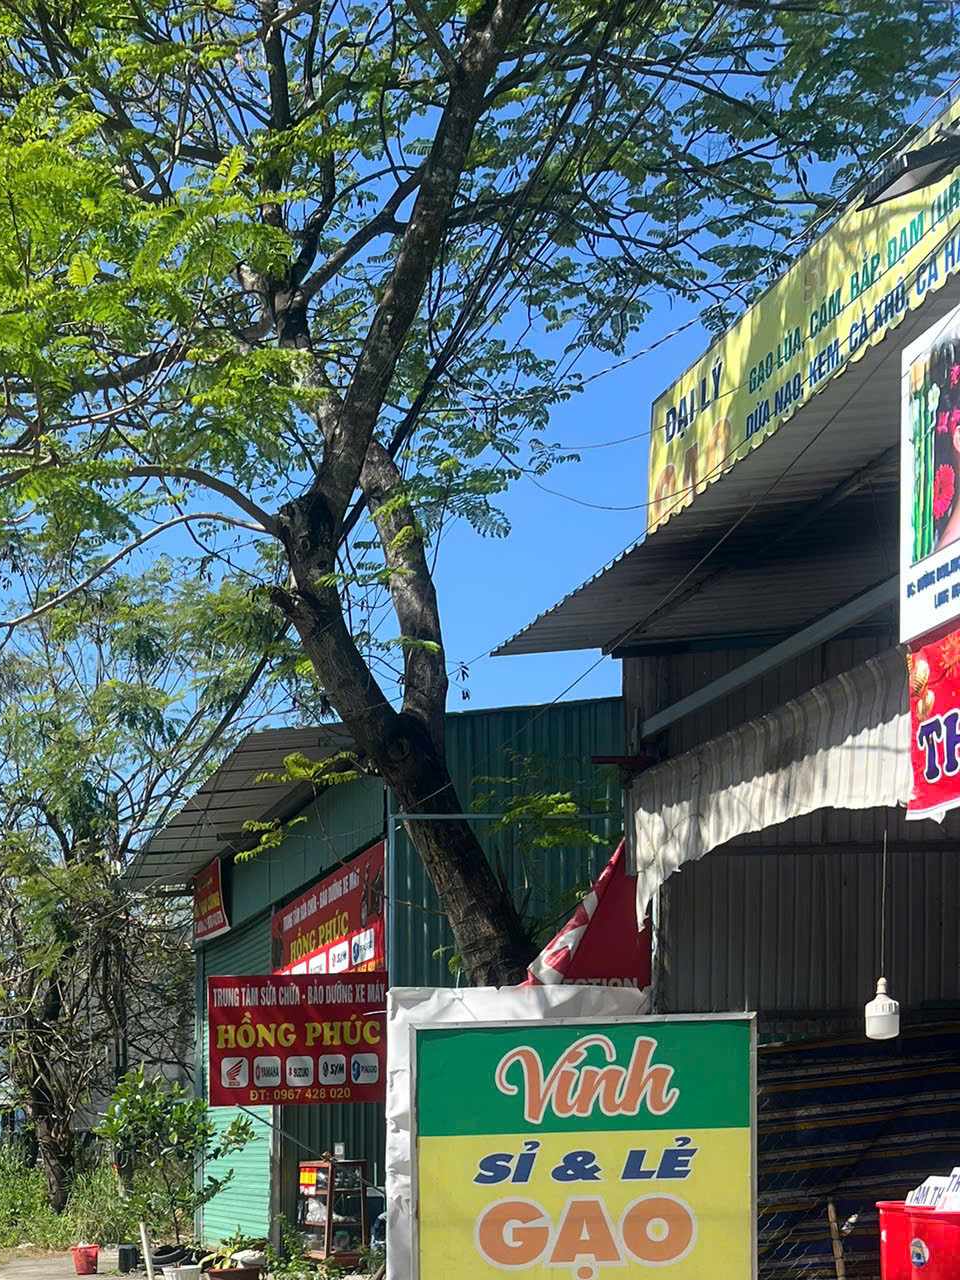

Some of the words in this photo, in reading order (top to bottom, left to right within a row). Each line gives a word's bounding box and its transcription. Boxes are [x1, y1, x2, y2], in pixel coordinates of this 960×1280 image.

[746, 401, 769, 440] DỪA
[849, 309, 869, 352] CÁ
[945, 235, 960, 272] H
[749, 352, 773, 394] GẠO
[665, 388, 695, 443] ĐẠI
[701, 356, 722, 412] LÝ
[318, 909, 349, 948] PHÚC
[213, 987, 240, 1008] TRUNG
[241, 983, 259, 1007] TÂM
[260, 980, 277, 1006] SỬA
[279, 982, 300, 1006] CHỮA
[307, 979, 324, 1005] BẢO
[325, 980, 353, 1004] DƯỠNG
[355, 984, 365, 1003] XE
[367, 979, 385, 1003] MÁY
[216, 1011, 297, 1049] HỒNG
[304, 1014, 381, 1046] PHÚC
[330, 1063, 345, 1075] SYM
[250, 1089, 270, 1101] ĐT:
[273, 1089, 301, 1100] 0967
[305, 1088, 326, 1099] 428
[330, 1087, 351, 1098] 020
[473, 1140, 541, 1185] SỈ
[551, 1149, 602, 1182] &
[620, 1136, 698, 1181] LẺ
